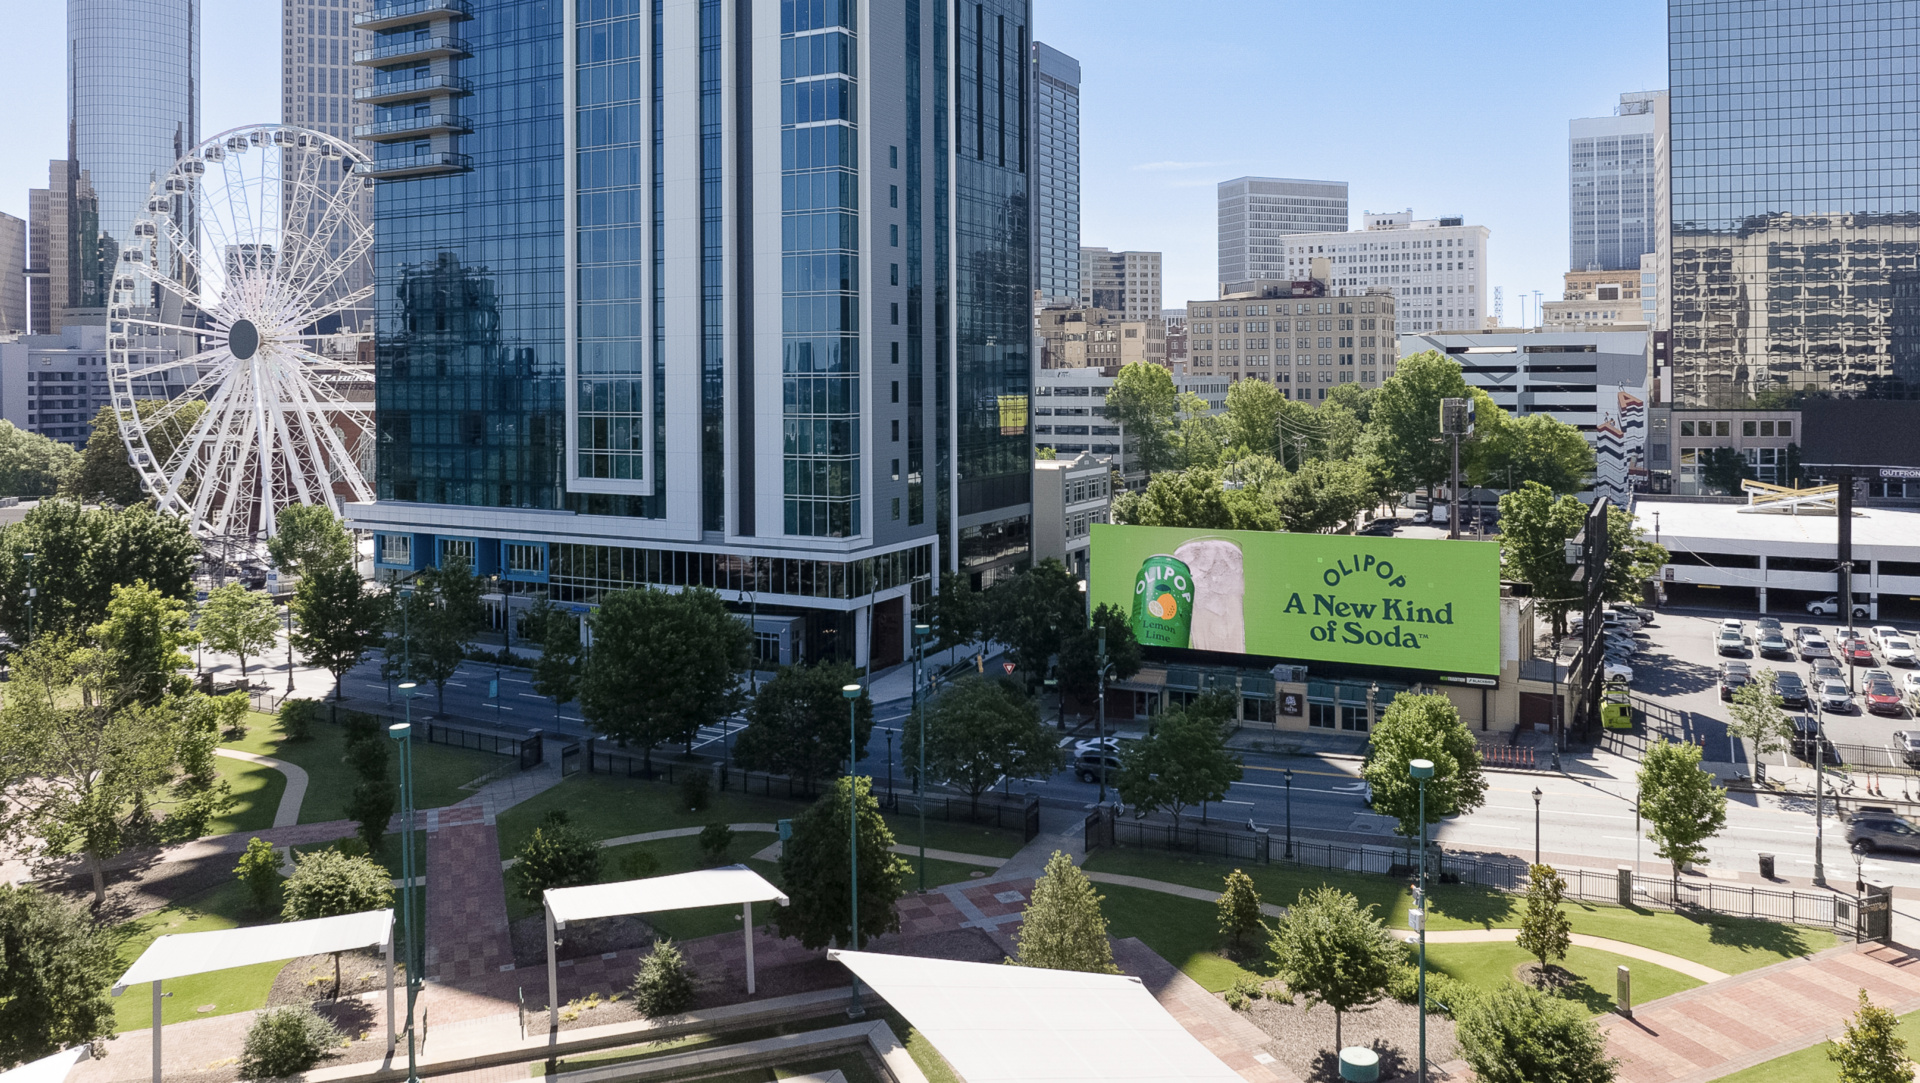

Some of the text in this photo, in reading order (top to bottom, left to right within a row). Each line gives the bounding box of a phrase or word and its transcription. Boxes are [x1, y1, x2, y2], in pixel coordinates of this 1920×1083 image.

[1882, 469, 1920, 477] OUTFRON
[1323, 554, 1406, 588] OLIPOP
[1136, 566, 1191, 603] OLIPOP
[1282, 592, 1454, 625] A New Kind
[1142, 620, 1176, 635] Lemon
[1145, 630, 1171, 643] Lime
[1310, 620, 1338, 643] of
